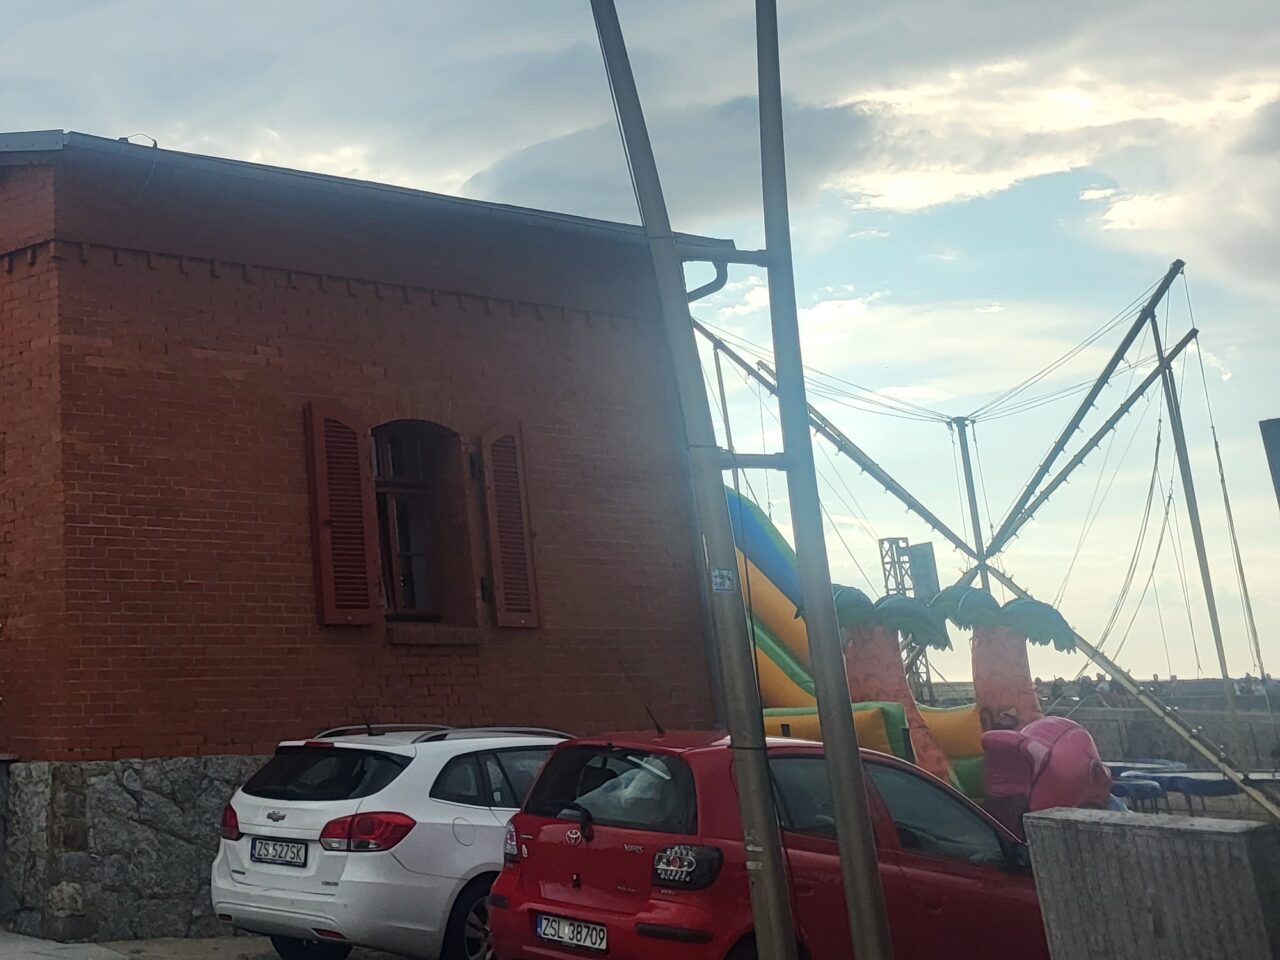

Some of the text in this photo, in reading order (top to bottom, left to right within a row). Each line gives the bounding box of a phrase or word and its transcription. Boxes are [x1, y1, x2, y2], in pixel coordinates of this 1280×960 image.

[257, 841, 303, 860] ZS 527SK
[543, 918, 606, 947] ZSL 38709
